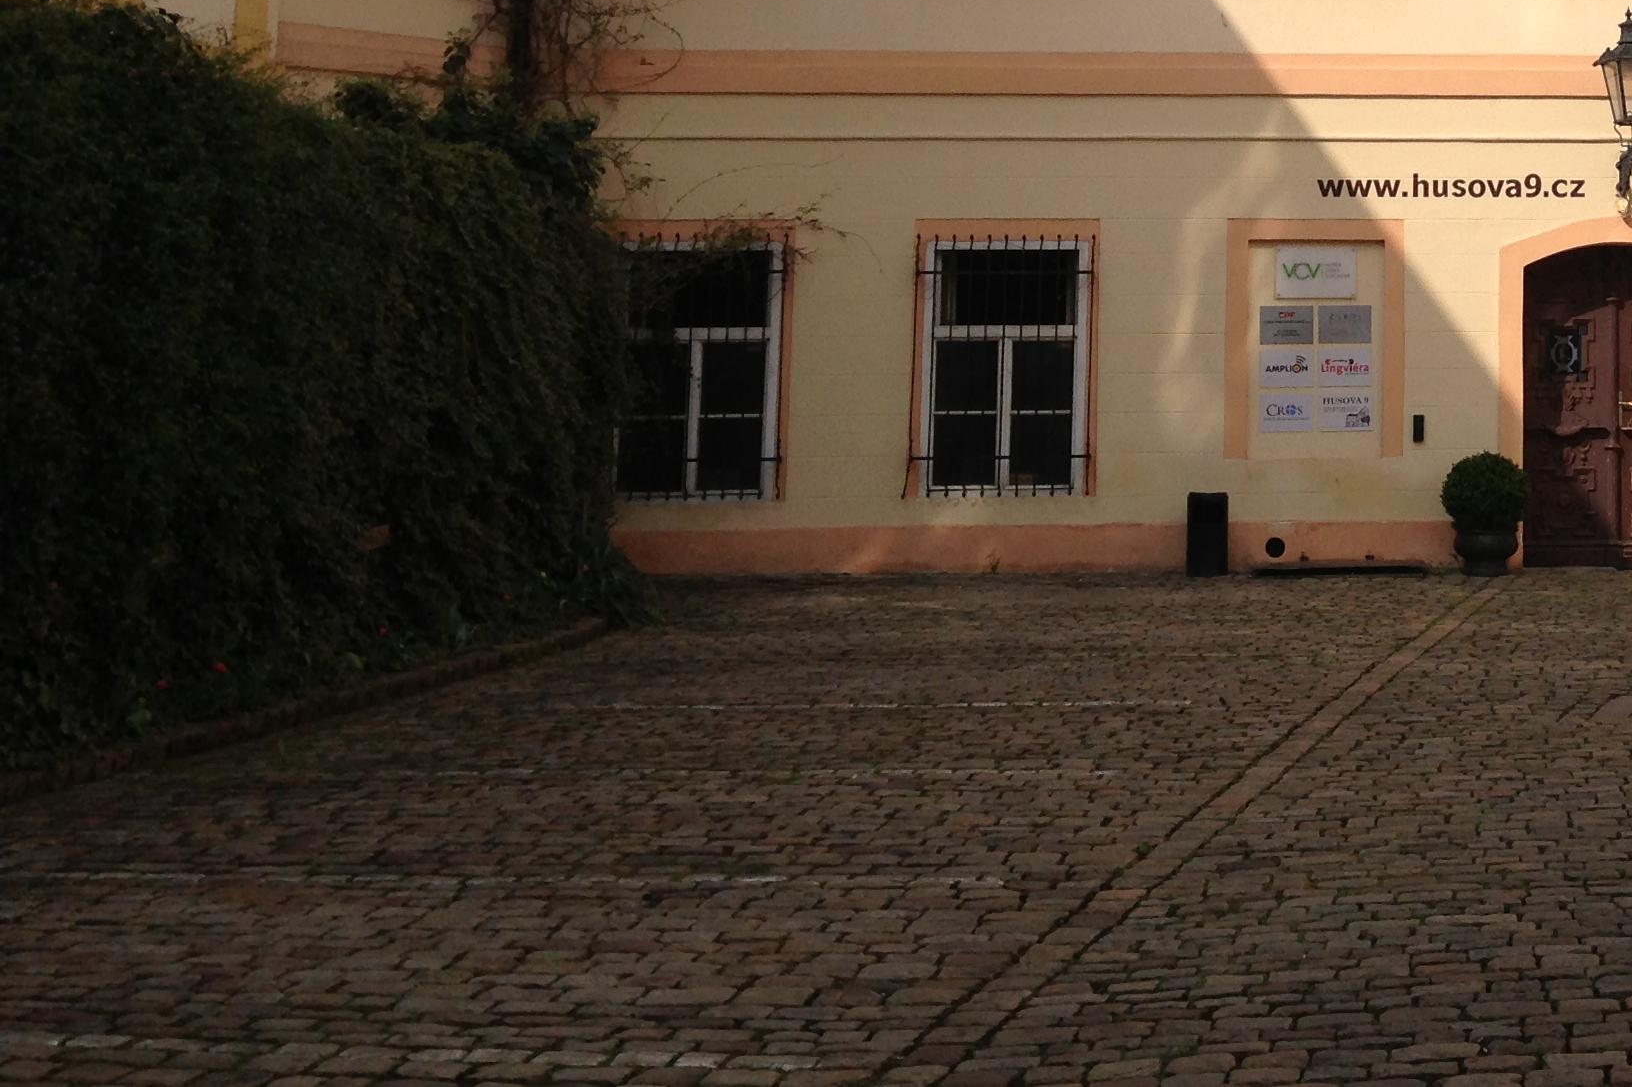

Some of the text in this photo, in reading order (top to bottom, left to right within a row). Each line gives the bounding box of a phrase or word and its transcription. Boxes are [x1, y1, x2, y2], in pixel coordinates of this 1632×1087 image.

[1317, 173, 1586, 198] www.husova9.cz
[1282, 263, 1321, 280] VCV
[1322, 397, 1362, 405] HUSOVA
